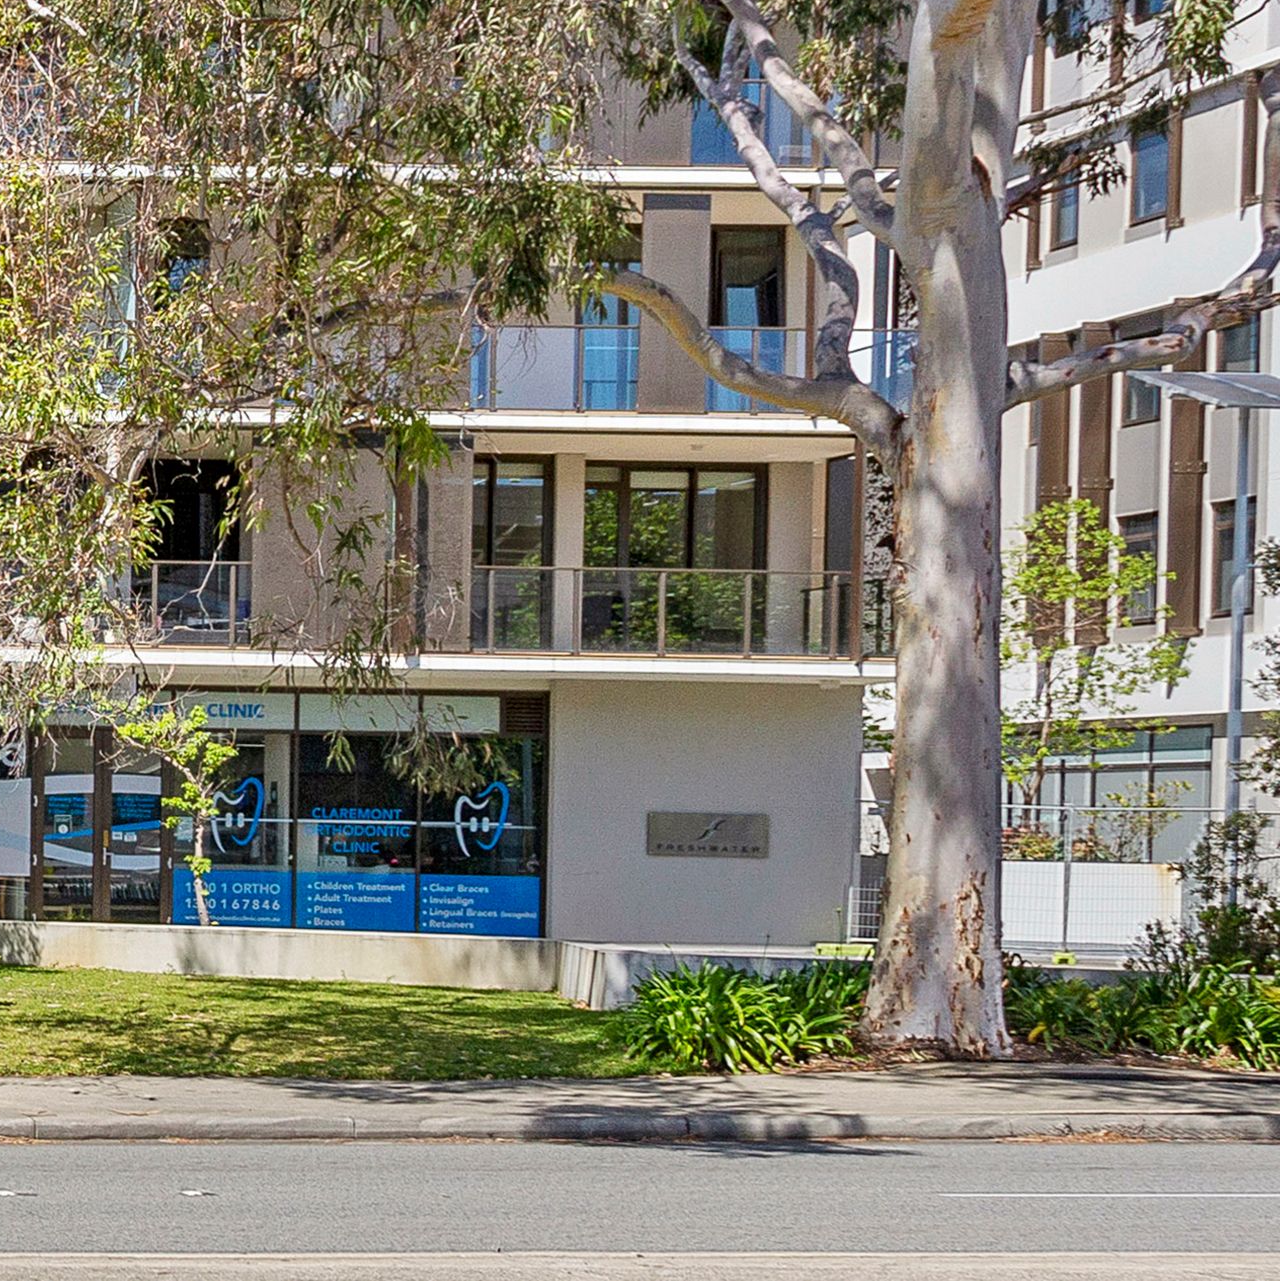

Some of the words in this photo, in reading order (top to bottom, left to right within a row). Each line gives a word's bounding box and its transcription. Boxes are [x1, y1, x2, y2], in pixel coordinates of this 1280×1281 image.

[207, 704, 265, 718] CLINIC
[311, 807, 402, 820] CLAREMONT
[332, 841, 380, 854] CLINIC
[657, 843, 761, 853] FRESHWATER
[231, 882, 281, 895] ORTHO
[313, 881, 354, 891] Children
[357, 882, 406, 892] Treatment
[429, 883, 454, 893] Clear
[457, 883, 489, 894] Braces
[313, 893, 341, 902] Adult
[343, 893, 392, 903] Treatment
[429, 895, 474, 907] Invisalign
[313, 905, 343, 914] Plates
[466, 907, 498, 918] Braces
[313, 917, 345, 926] Braces
[429, 919, 474, 929] Retainers
